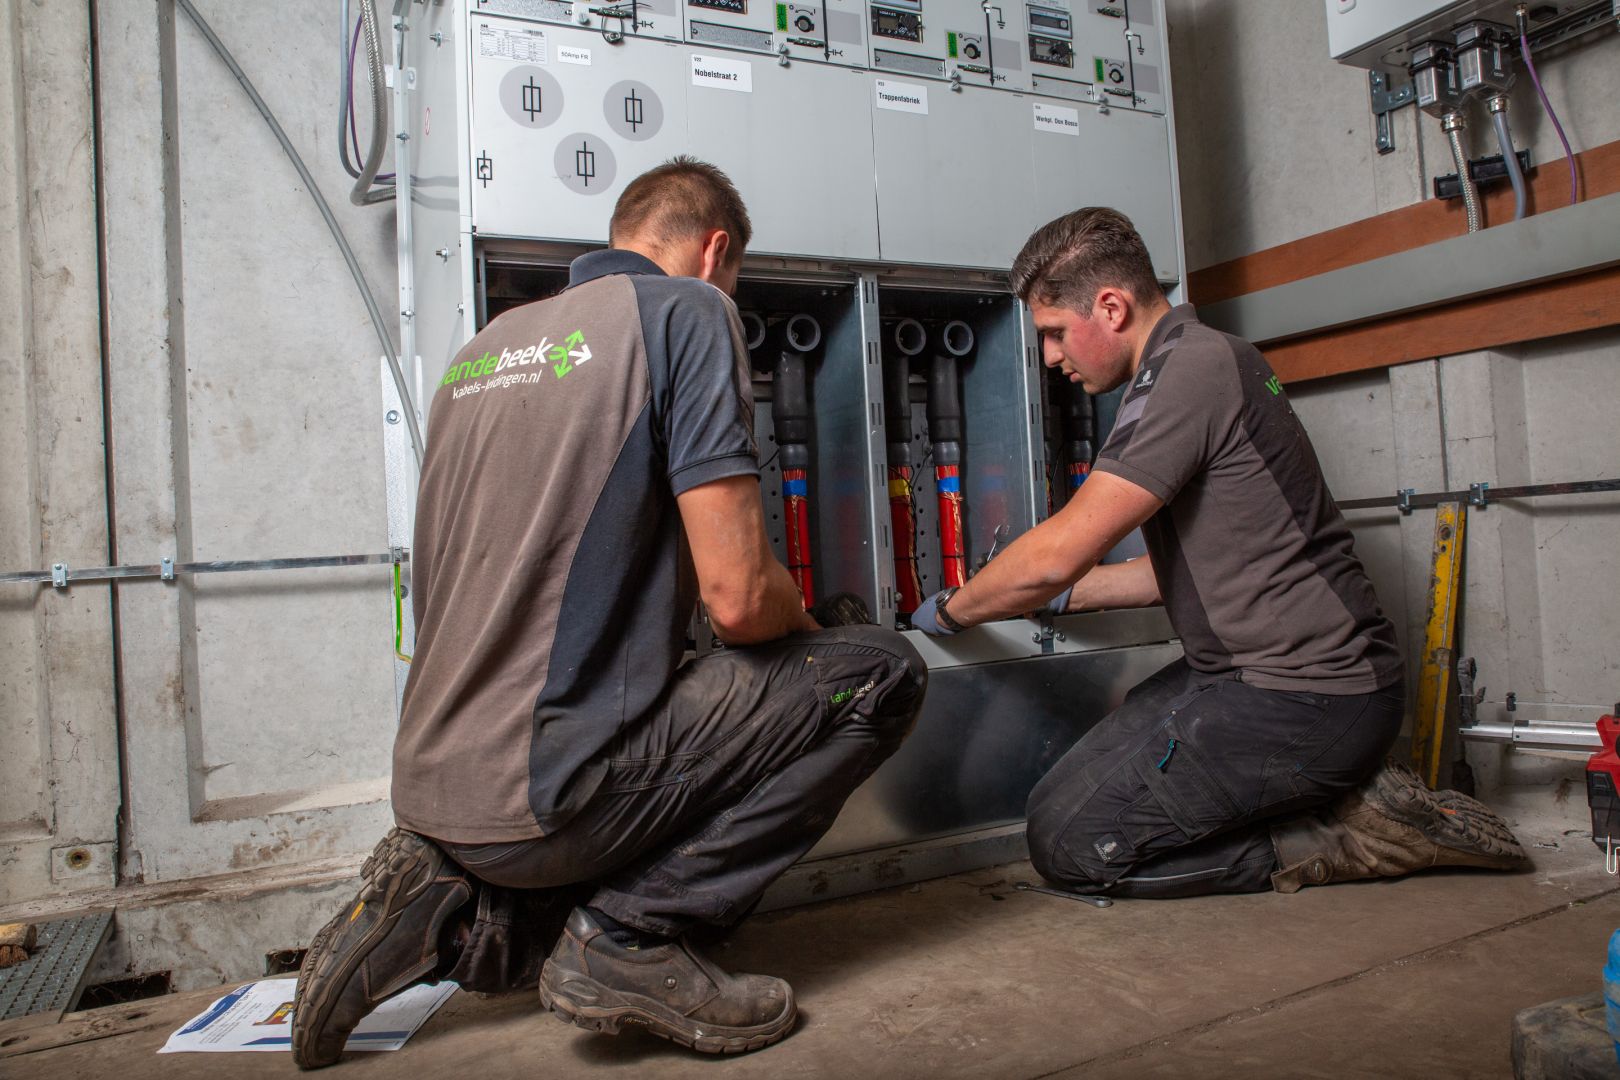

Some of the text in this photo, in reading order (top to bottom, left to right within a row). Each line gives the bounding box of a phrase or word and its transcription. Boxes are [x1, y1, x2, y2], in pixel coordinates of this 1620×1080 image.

[694, 68, 738, 81] Nobelstraat 2
[879, 92, 921, 105] Trappenfabriek
[437, 337, 554, 388] andebeek
